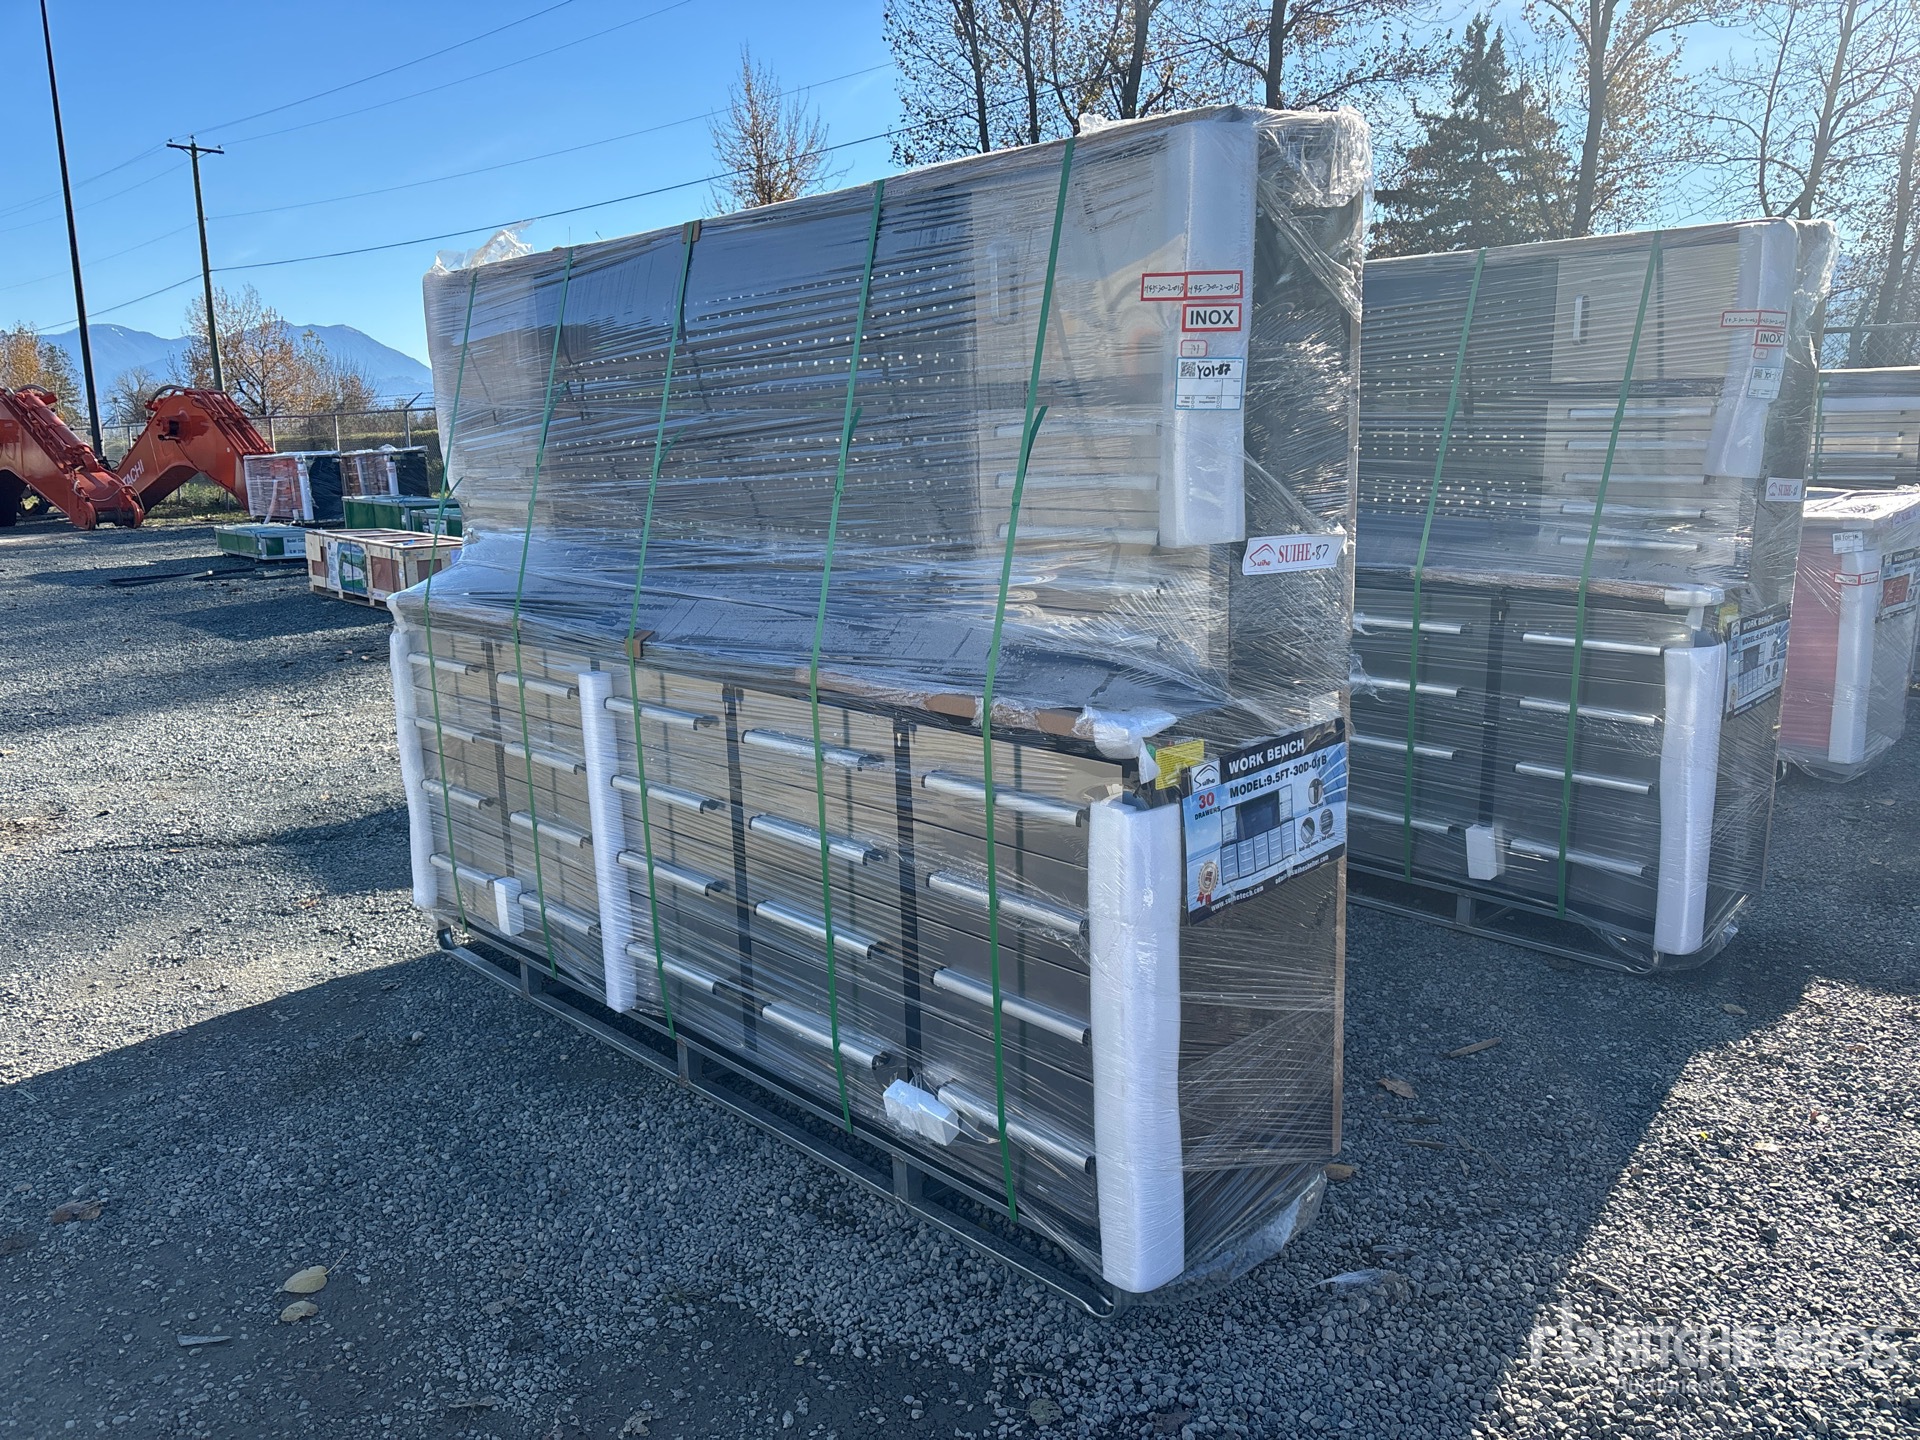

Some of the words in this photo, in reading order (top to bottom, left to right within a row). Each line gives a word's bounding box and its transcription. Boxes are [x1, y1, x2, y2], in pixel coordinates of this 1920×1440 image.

[1190, 309, 1234, 325] INOX
[1760, 333, 1782, 344] INOX
[1228, 751, 1265, 775] WORK
[1267, 738, 1305, 762] BENCH
[1199, 791, 1215, 810] 30
[1194, 805, 1221, 821] DRAWERS
